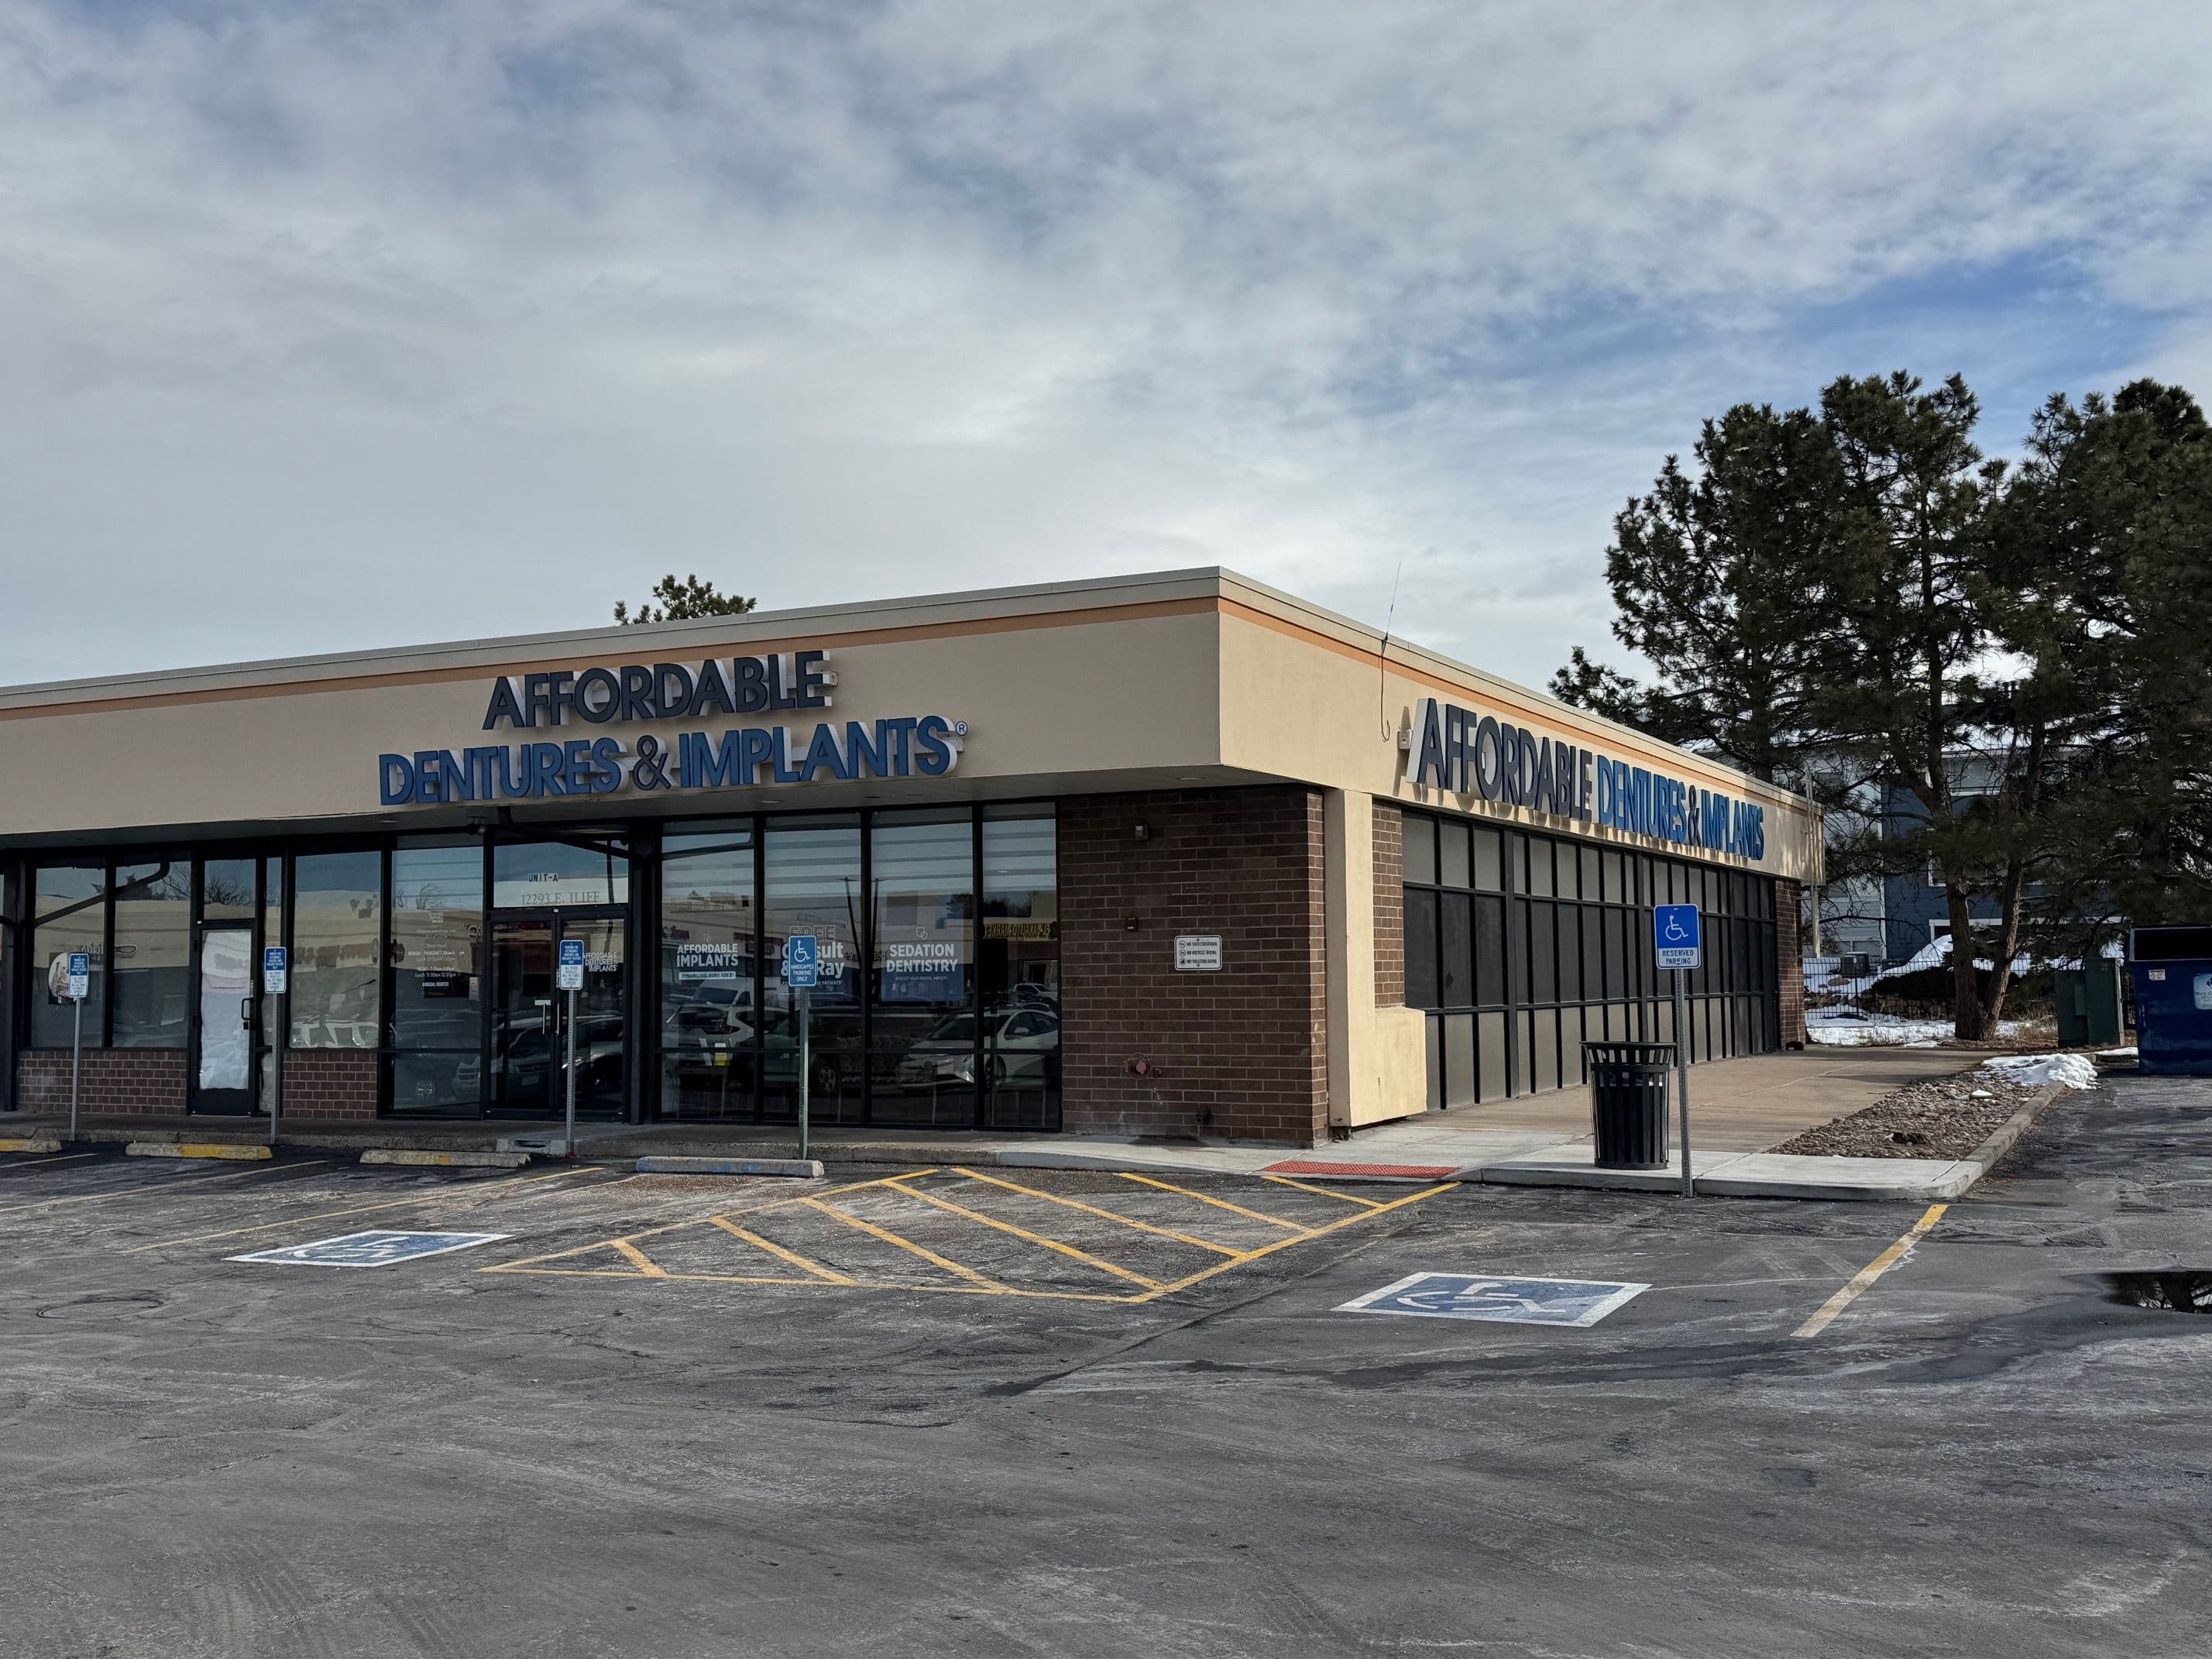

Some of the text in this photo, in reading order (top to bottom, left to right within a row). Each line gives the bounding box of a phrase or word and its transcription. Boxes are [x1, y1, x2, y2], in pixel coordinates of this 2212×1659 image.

[482, 650, 833, 730] AFFORDABLE
[378, 737, 624, 805] DENTURES
[633, 734, 672, 791] &
[1417, 697, 1764, 860] AFFORDABLE DENTURES & IMPLANTS
[528, 873, 558, 882] UNIT-A
[521, 892, 550, 905] 12293
[789, 924, 836, 943] FREE
[677, 943, 738, 954] AFFORDABLE
[781, 941, 844, 960] Csult
[889, 943, 954, 957] SEDATION
[676, 953, 739, 967] IMPLANTS
[886, 959, 959, 973] DENTISTRY
